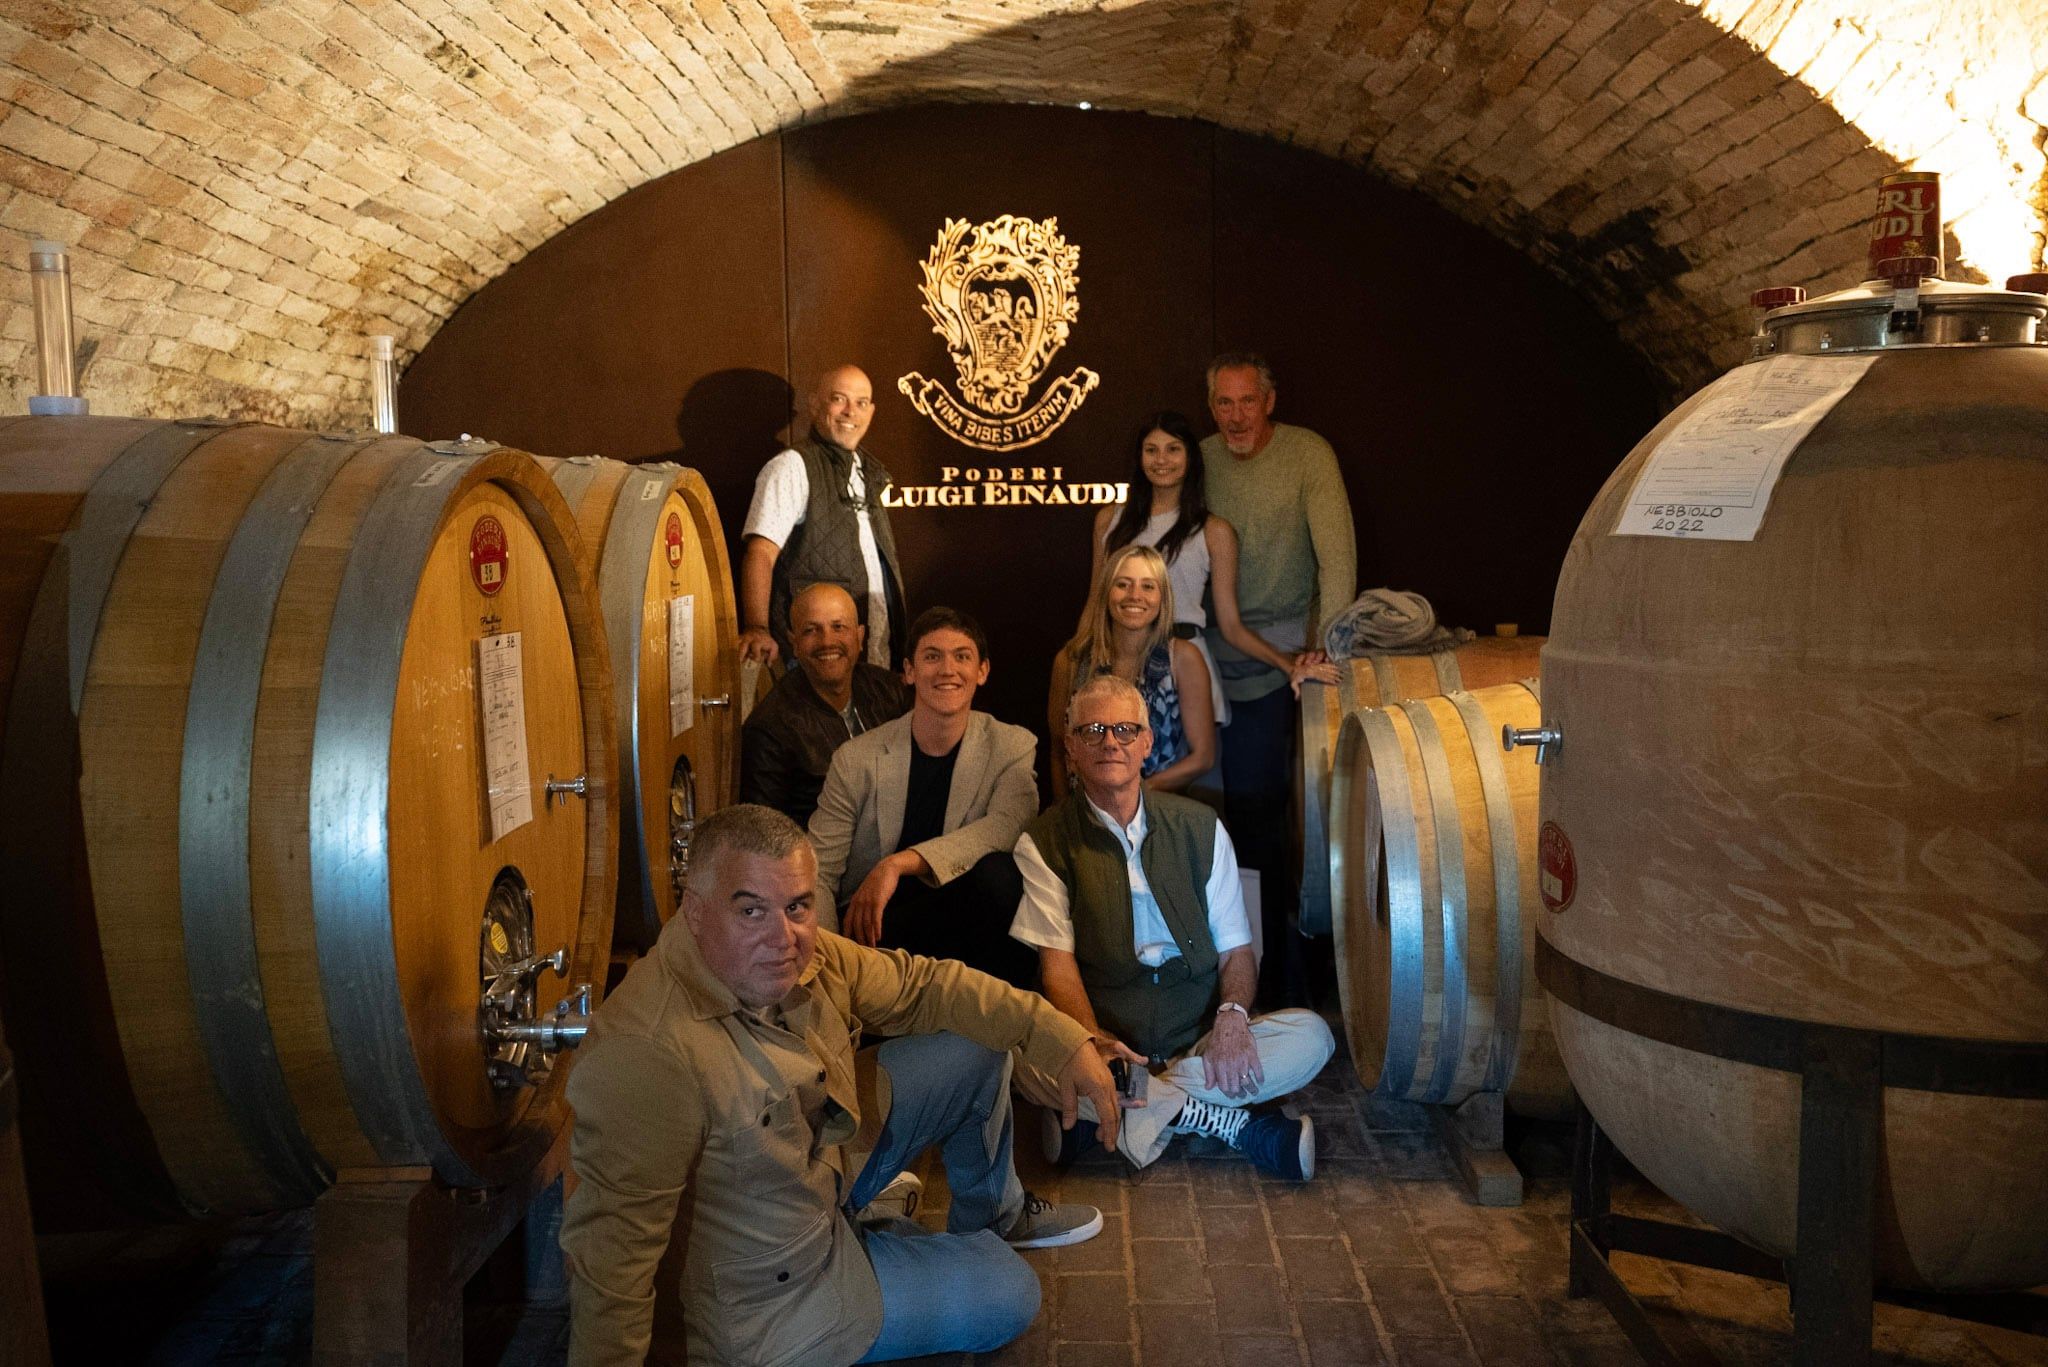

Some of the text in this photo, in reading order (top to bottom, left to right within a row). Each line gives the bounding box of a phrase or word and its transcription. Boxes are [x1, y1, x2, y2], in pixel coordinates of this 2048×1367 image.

[933, 391, 1068, 443] VINA BIBES ITERVM
[942, 466, 1063, 482] PODERI
[880, 481, 1130, 507] LUIGI EINAUDI
[1644, 504, 1723, 518] NEBBIOLO
[1652, 518, 1704, 532] 2022
